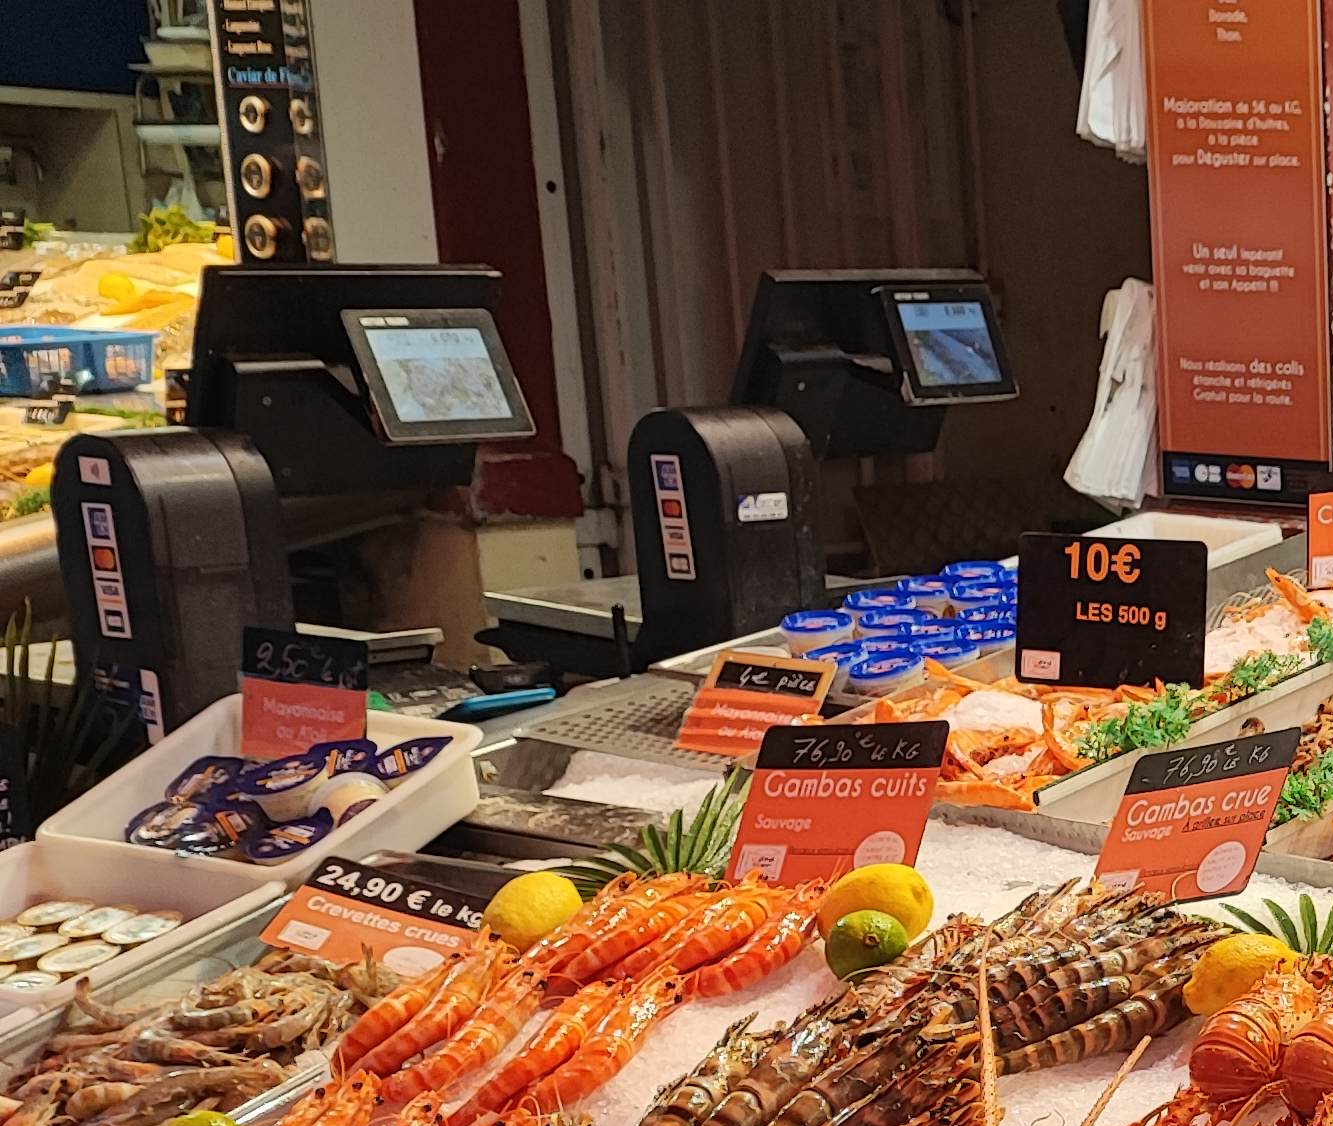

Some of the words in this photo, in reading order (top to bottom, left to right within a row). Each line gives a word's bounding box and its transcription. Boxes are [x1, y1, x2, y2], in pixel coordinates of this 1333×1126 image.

[1064, 541, 1142, 584] 10€
[1075, 601, 1113, 623] LES
[1118, 603, 1150, 625] 500
[1154, 609, 1168, 631] g
[763, 772, 864, 800] Gambas
[869, 770, 928, 799] cuits
[754, 813, 813, 832] Sauvage
[1126, 794, 1219, 826] Gambas
[1219, 783, 1270, 814] crue
[316, 865, 403, 903] 24,90
[306, 896, 400, 934] Crevettes
[404, 924, 460, 949] crues
